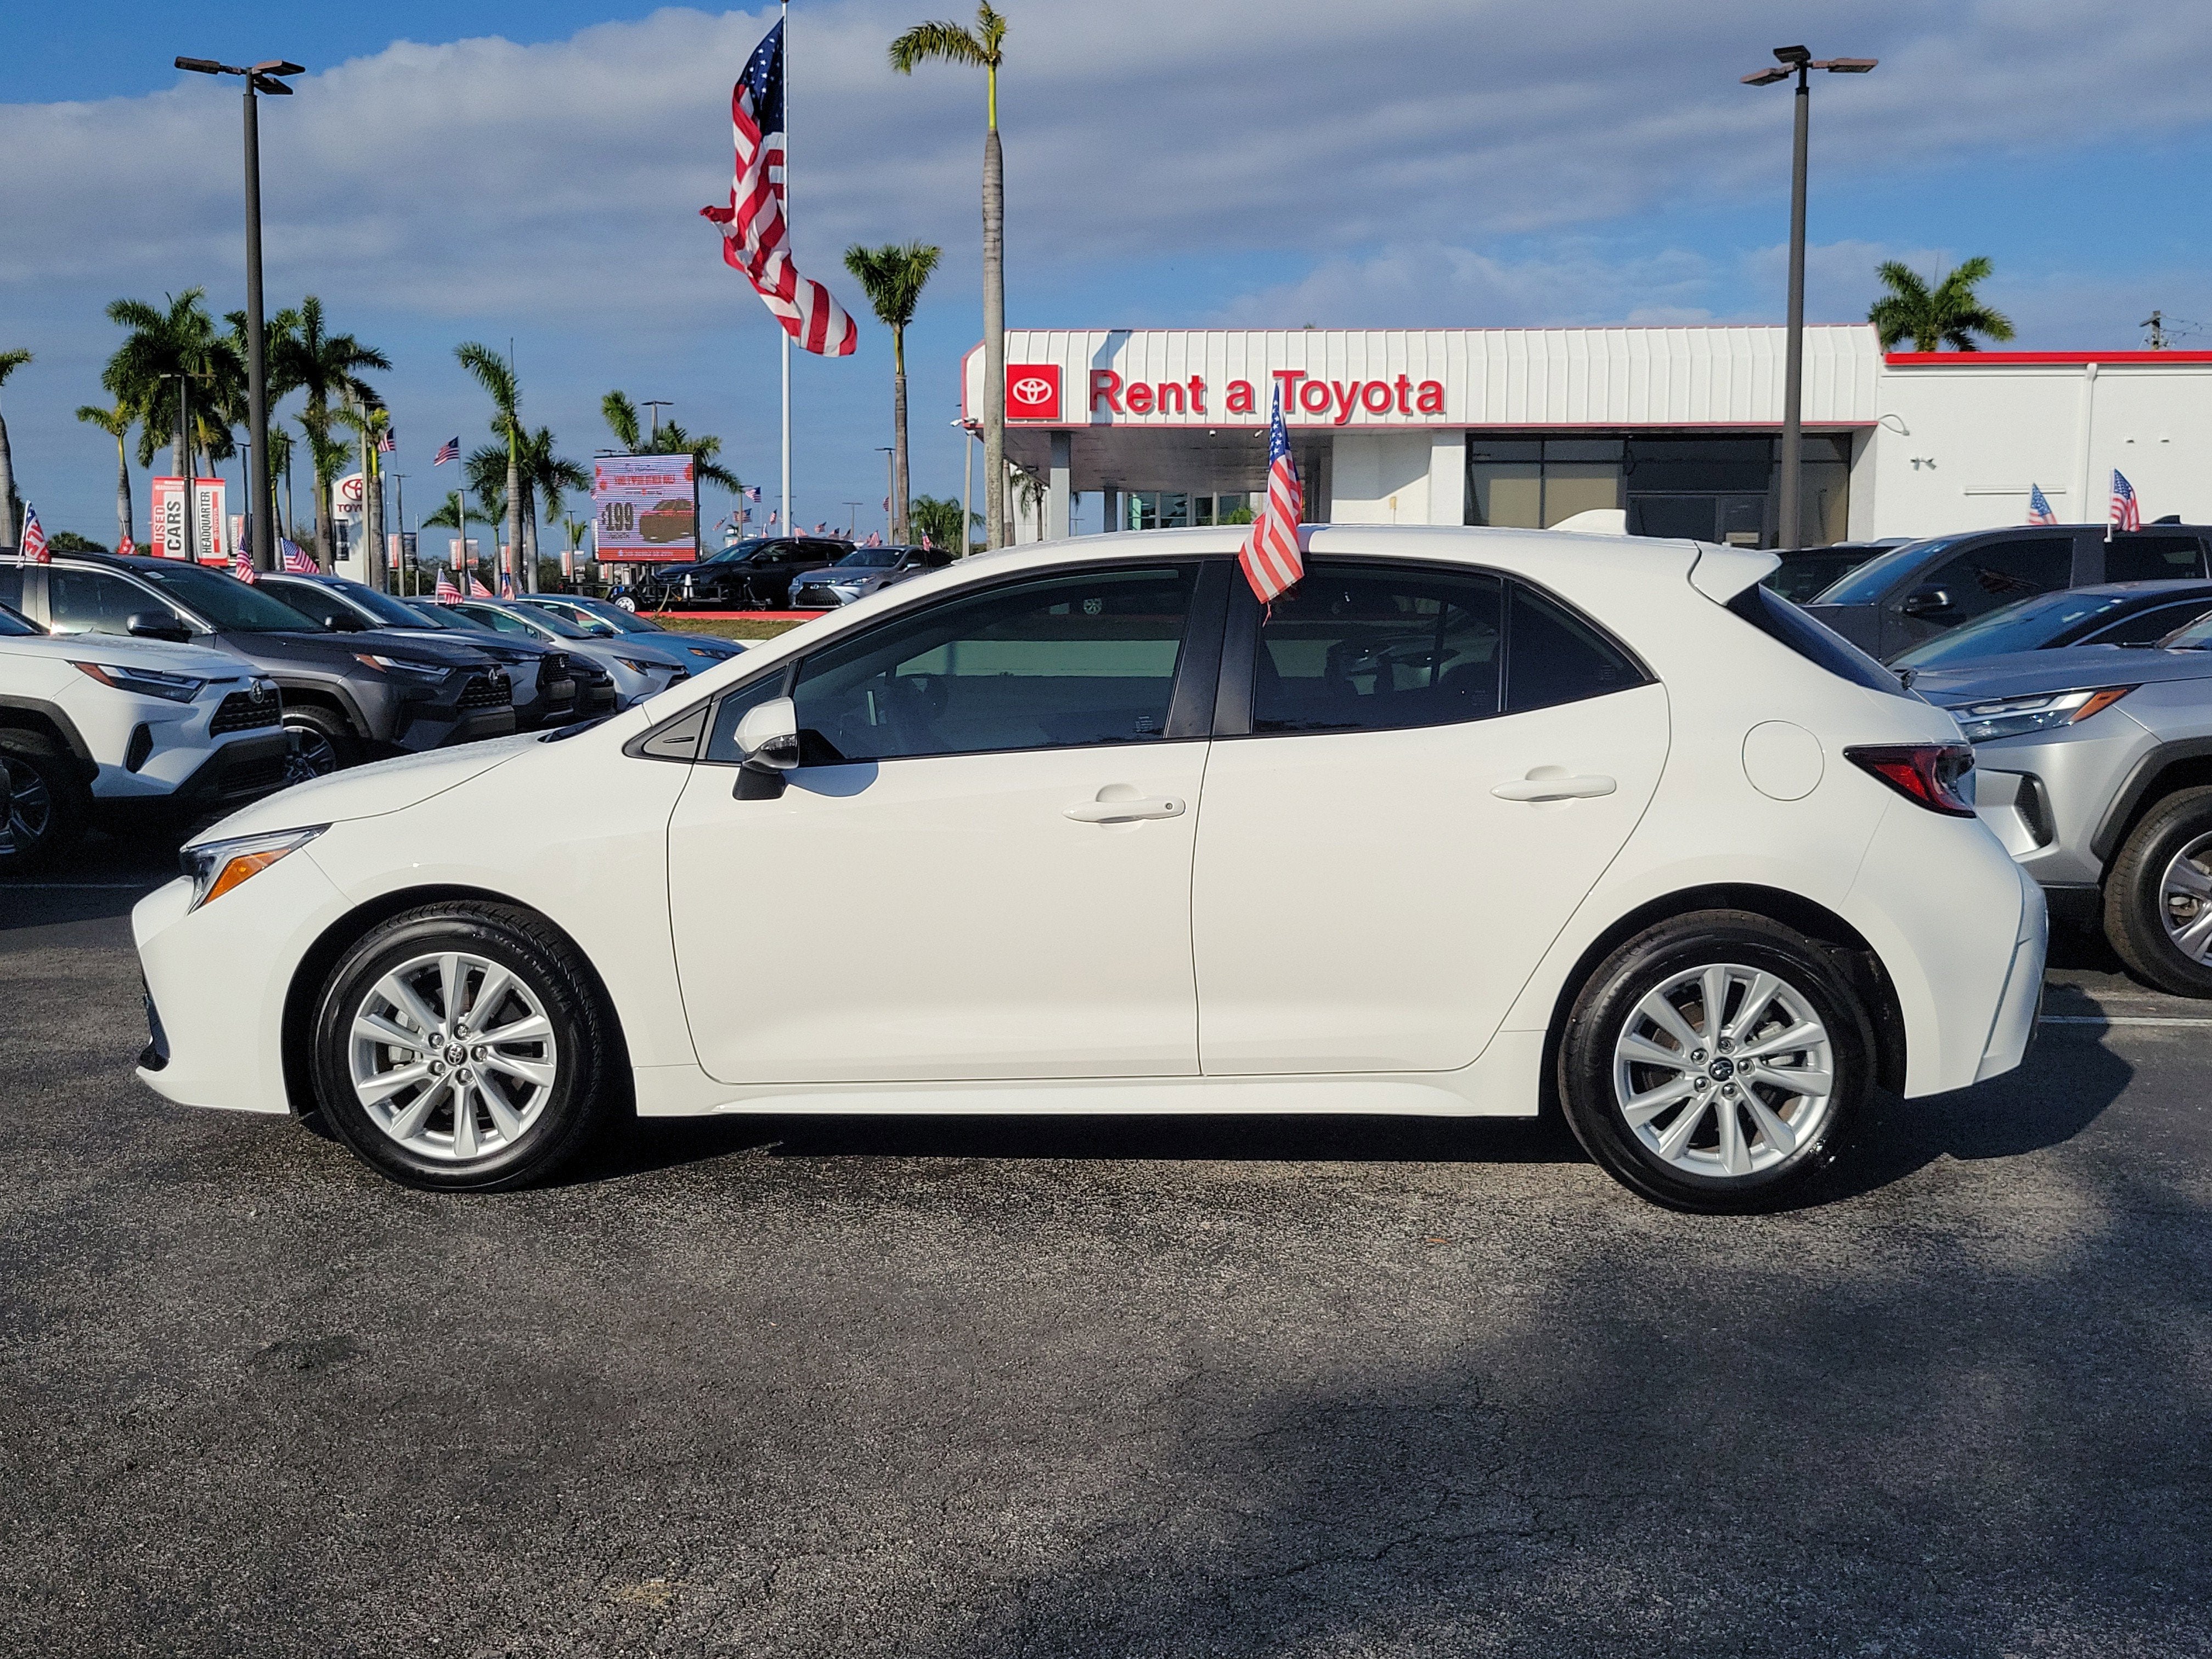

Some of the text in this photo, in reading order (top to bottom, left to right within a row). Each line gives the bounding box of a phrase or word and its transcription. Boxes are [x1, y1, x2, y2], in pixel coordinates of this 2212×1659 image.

[1090, 369, 1445, 425] Rent a Toyota
[155, 506, 165, 541] USED
[167, 501, 182, 551] CARS
[200, 491, 212, 554] HEADQUARTER
